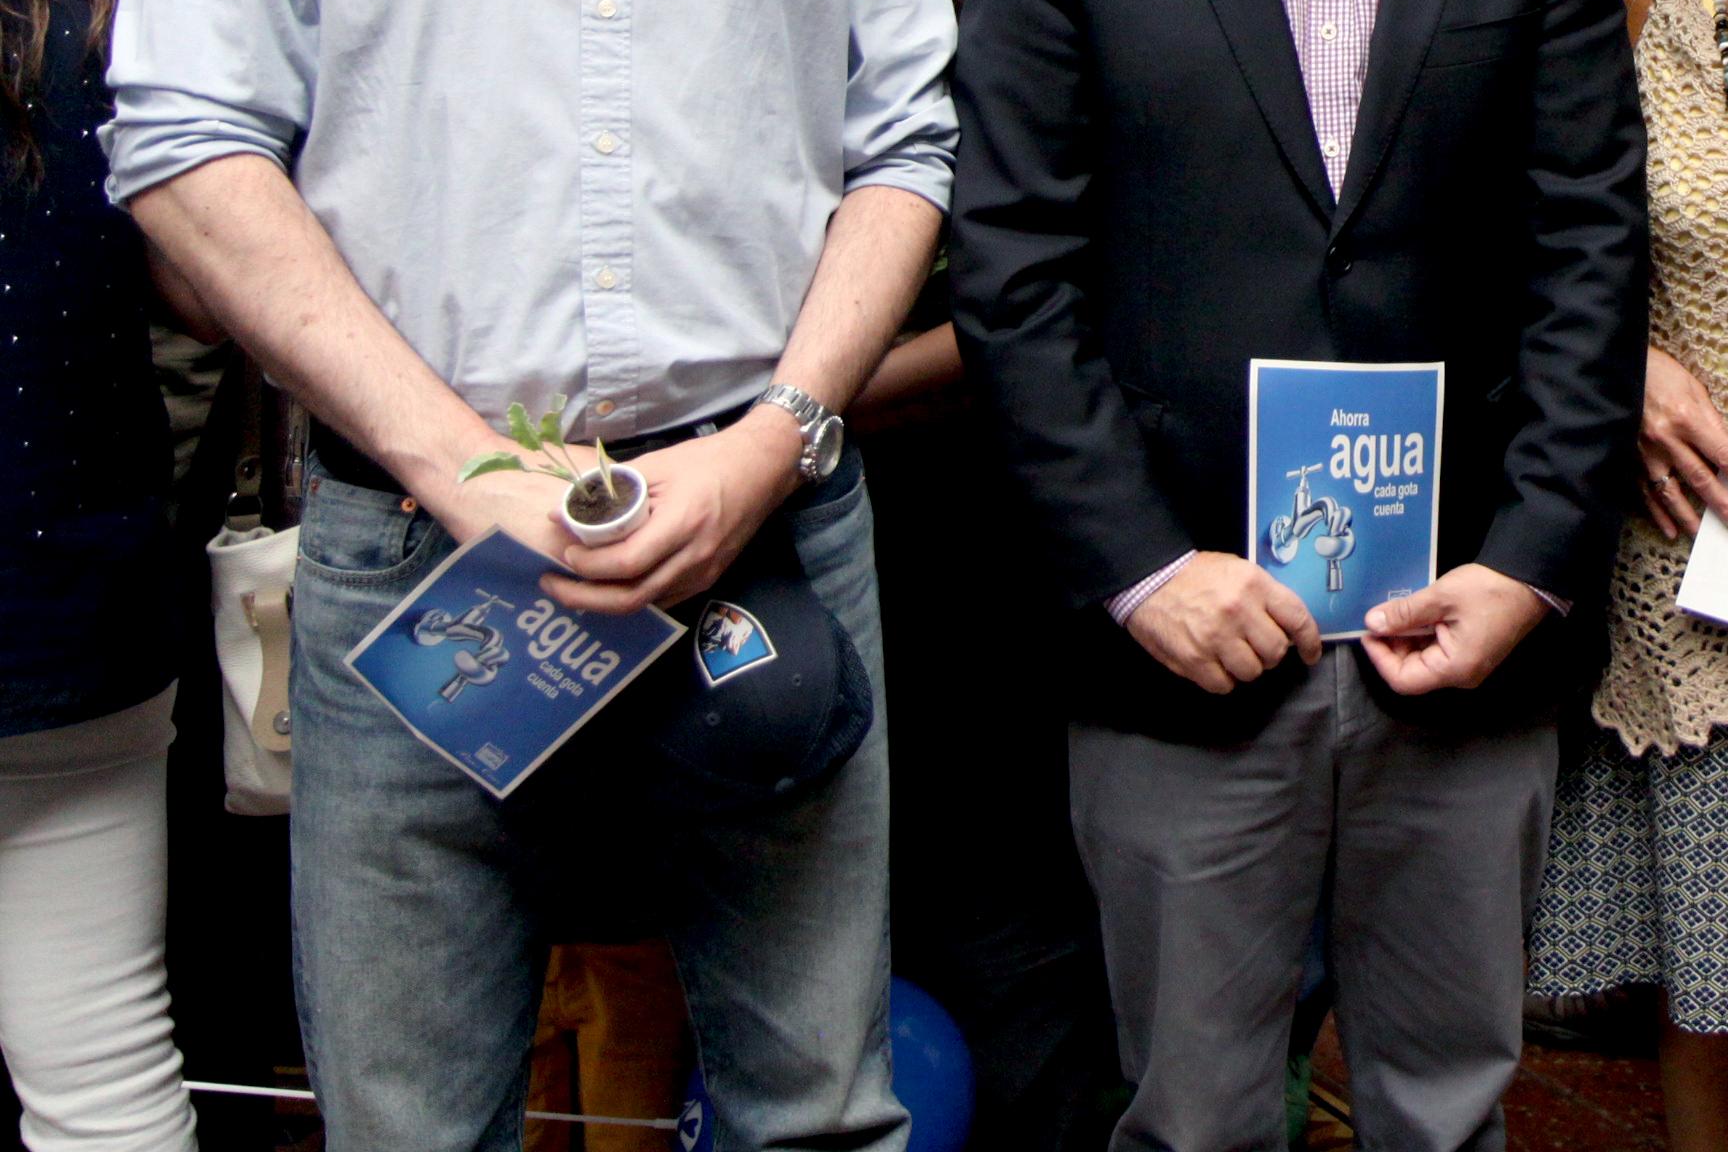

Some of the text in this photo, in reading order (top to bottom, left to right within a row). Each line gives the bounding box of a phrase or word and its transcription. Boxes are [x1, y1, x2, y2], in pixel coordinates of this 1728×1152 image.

[1330, 408, 1370, 426] Ahorra
[1330, 432, 1424, 494] agua
[1374, 481, 1418, 500] cada gota
[1373, 501, 1405, 517] cuenta
[516, 599, 621, 686] agua
[527, 672, 559, 699] cuenta
[540, 660, 584, 697] cada gota
